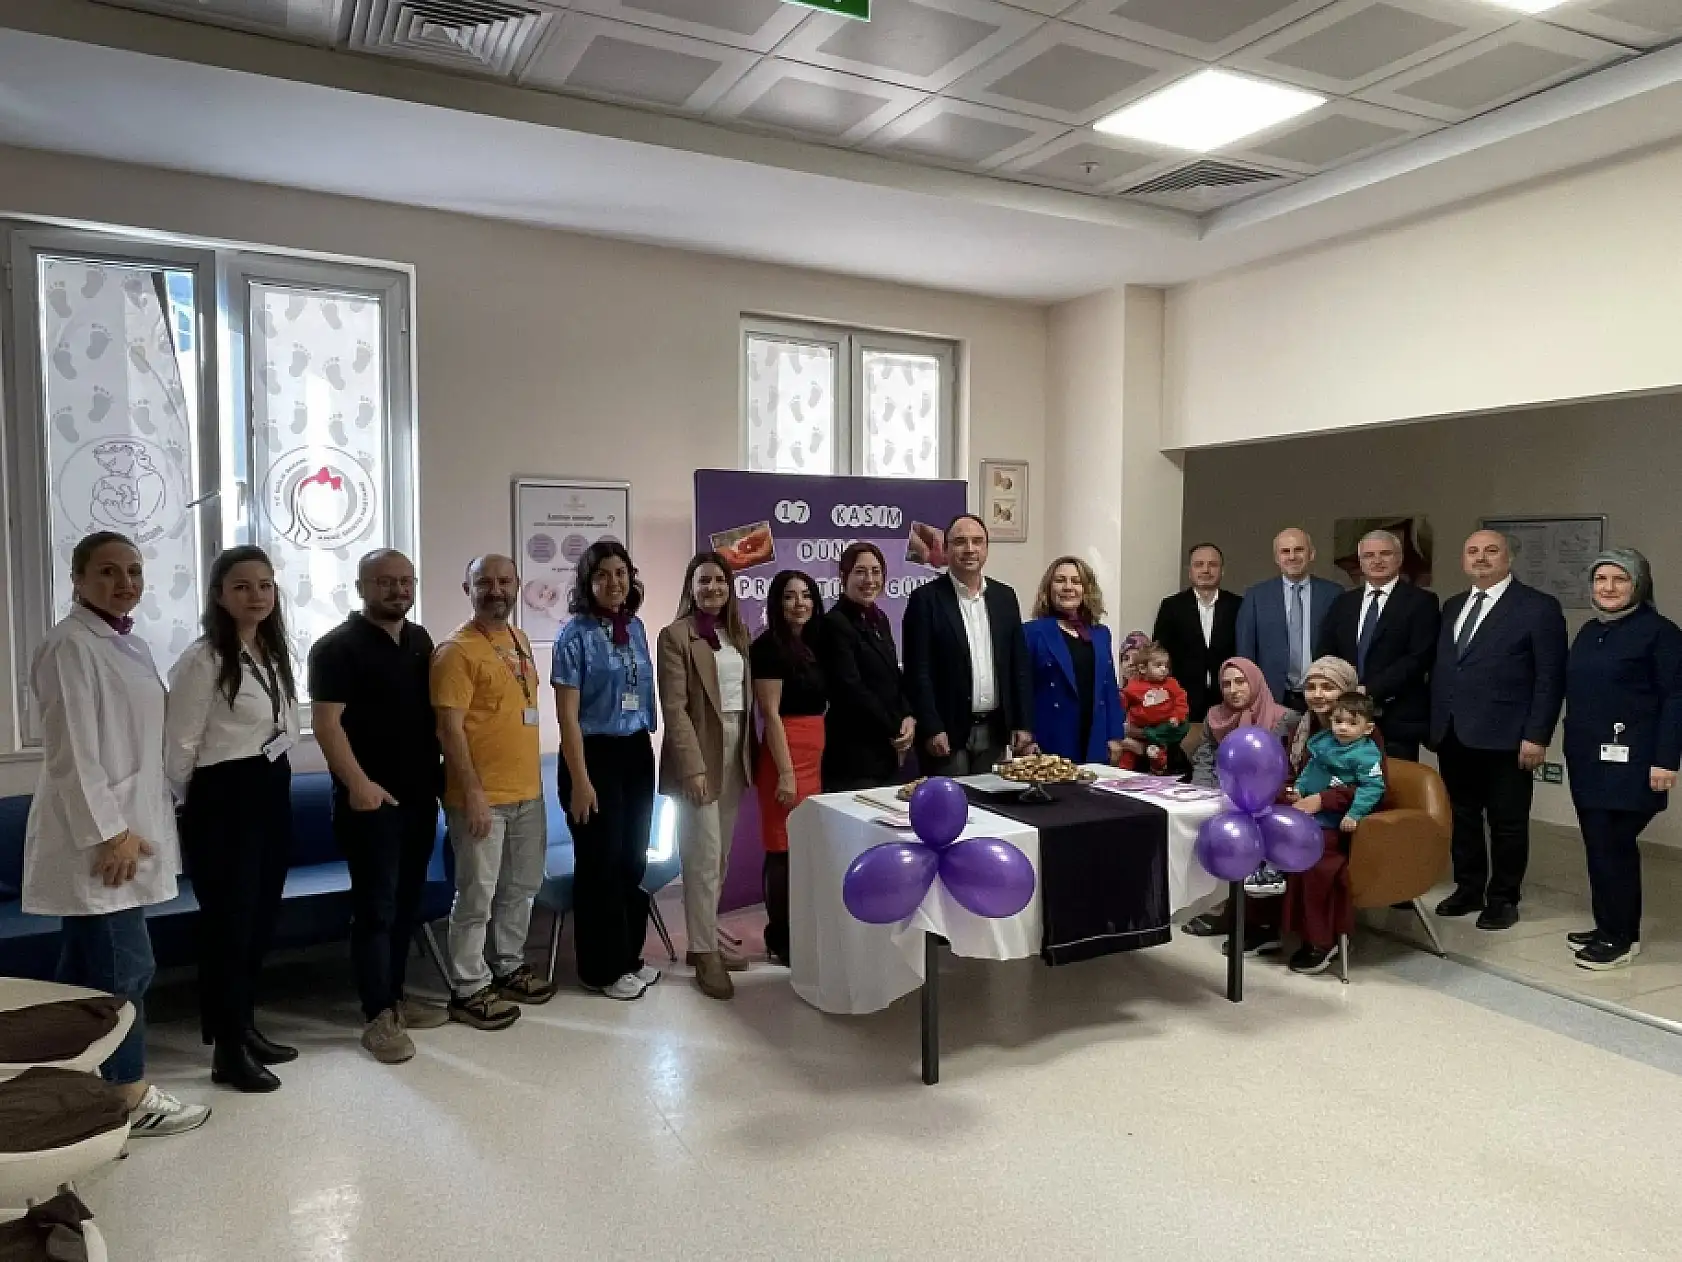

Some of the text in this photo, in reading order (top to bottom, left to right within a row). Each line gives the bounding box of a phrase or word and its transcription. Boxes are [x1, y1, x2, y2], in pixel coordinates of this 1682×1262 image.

[780, 503, 901, 525] 17 KASIM
[801, 540, 844, 560] DÜN
